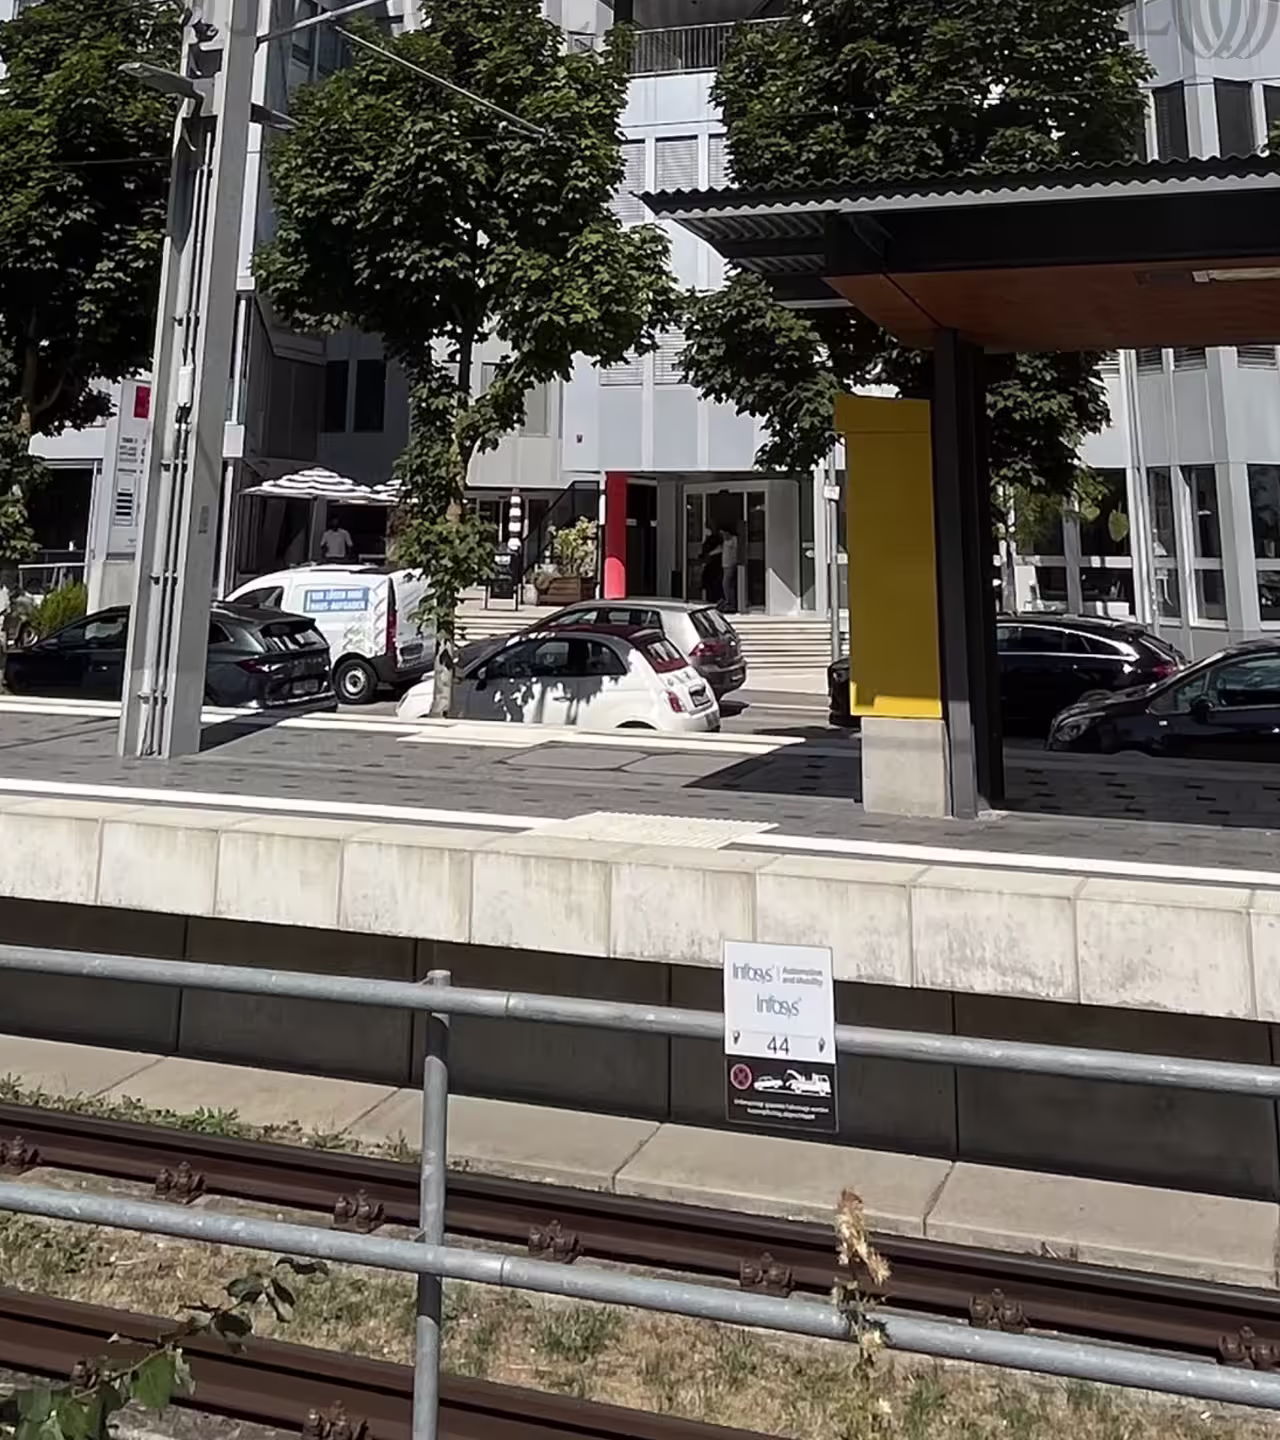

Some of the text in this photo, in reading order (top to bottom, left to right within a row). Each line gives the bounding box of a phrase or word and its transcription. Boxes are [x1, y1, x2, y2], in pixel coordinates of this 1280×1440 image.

[732, 962, 775, 984] Infosys
[756, 993, 802, 1018] Infosys
[766, 1035, 790, 1055] 44
